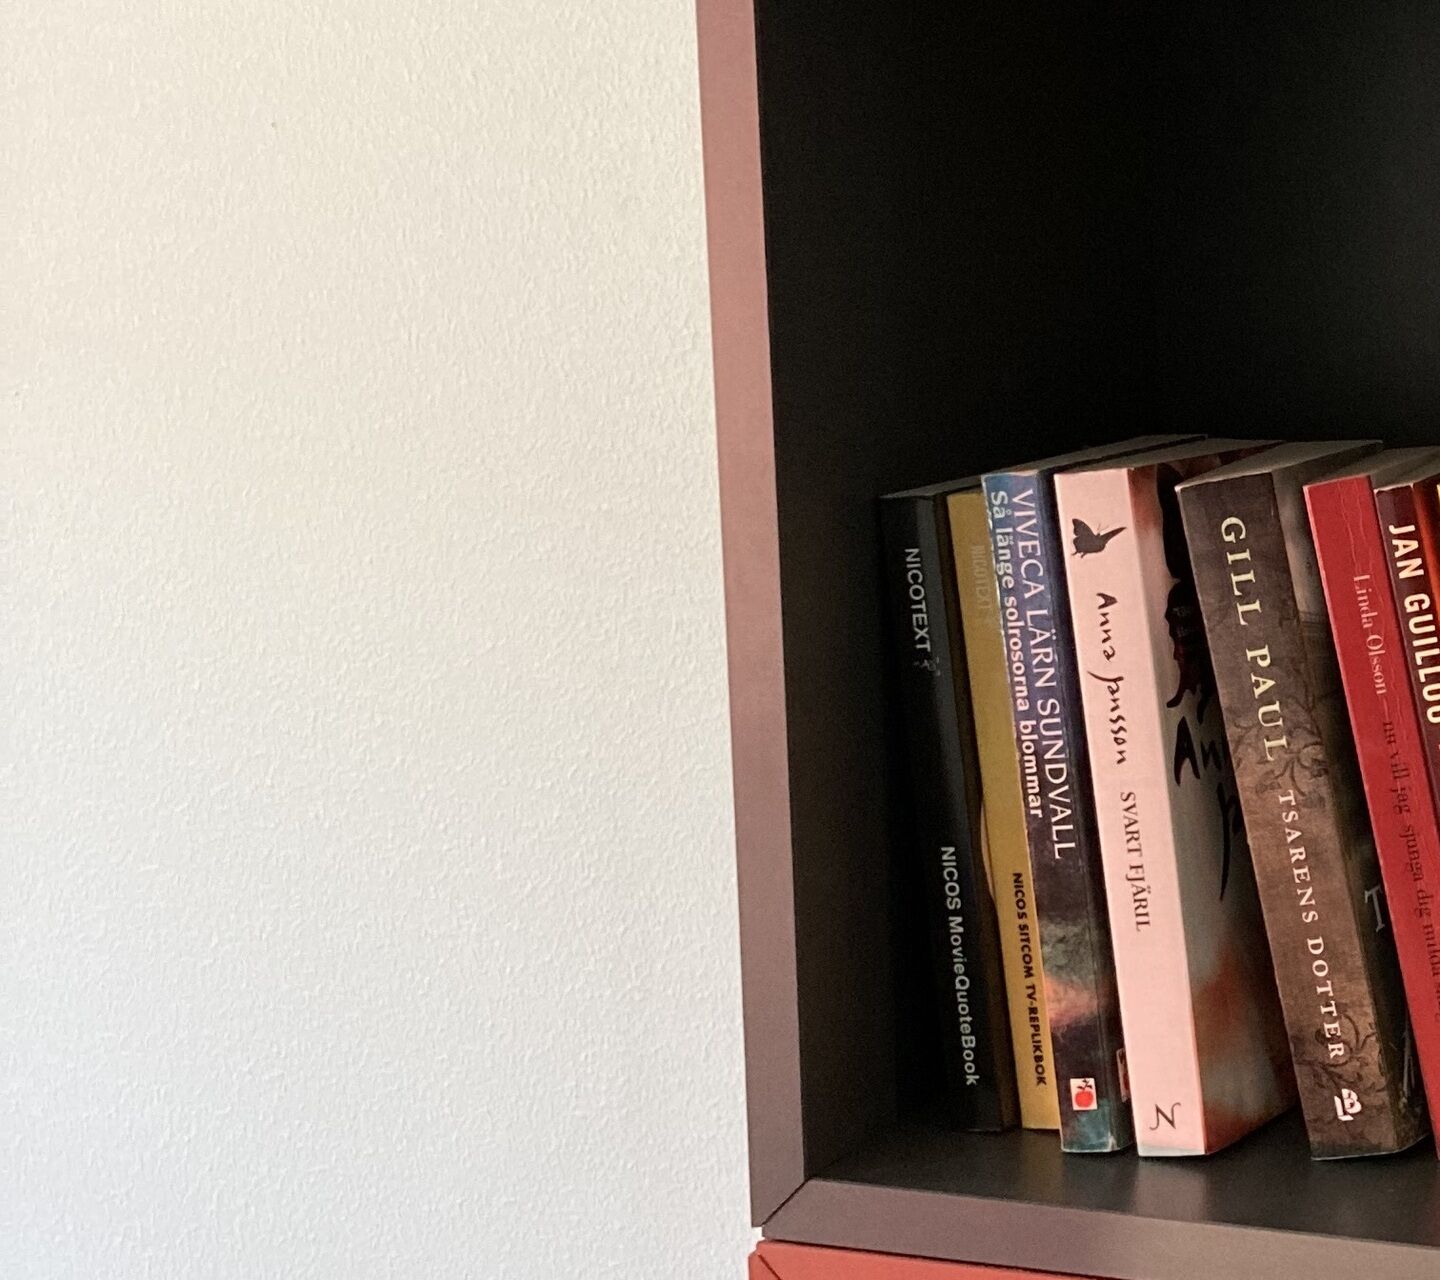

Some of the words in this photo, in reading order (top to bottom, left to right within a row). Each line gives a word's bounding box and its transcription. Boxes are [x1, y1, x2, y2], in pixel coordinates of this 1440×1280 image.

[991, 490, 1012, 519] Så
[1012, 489, 1045, 599] VIVECA
[996, 527, 1016, 589] länge
[1388, 524, 1424, 579] JAN
[904, 548, 931, 652] NICOTEXT
[1096, 592, 1119, 662] Anna
[1221, 516, 1262, 626] GILL
[1245, 644, 1288, 762] PAUL
[1354, 574, 1378, 629] Linda
[1366, 633, 1388, 695] Olsson
[1004, 596, 1030, 712] solrosorna
[1026, 609, 1057, 689] LÄRN
[1087, 670, 1128, 765] Jansson
[1019, 720, 1043, 818] blommar
[1037, 698, 1076, 860] SUNDVALL
[1120, 791, 1143, 858] SVART
[1400, 823, 1425, 882] sjunga
[941, 846, 962, 910] NICOS
[1013, 872, 1028, 920] NICOS
[1126, 863, 1152, 932] FJÄRIL
[1018, 923, 1034, 980] SITCOM
[1278, 789, 1319, 924] TSARENS
[1307, 936, 1345, 1060] DOTTER
[947, 915, 980, 1086] MovieQuoteBook
[1024, 984, 1047, 1086] TV-REPLIKBOK
